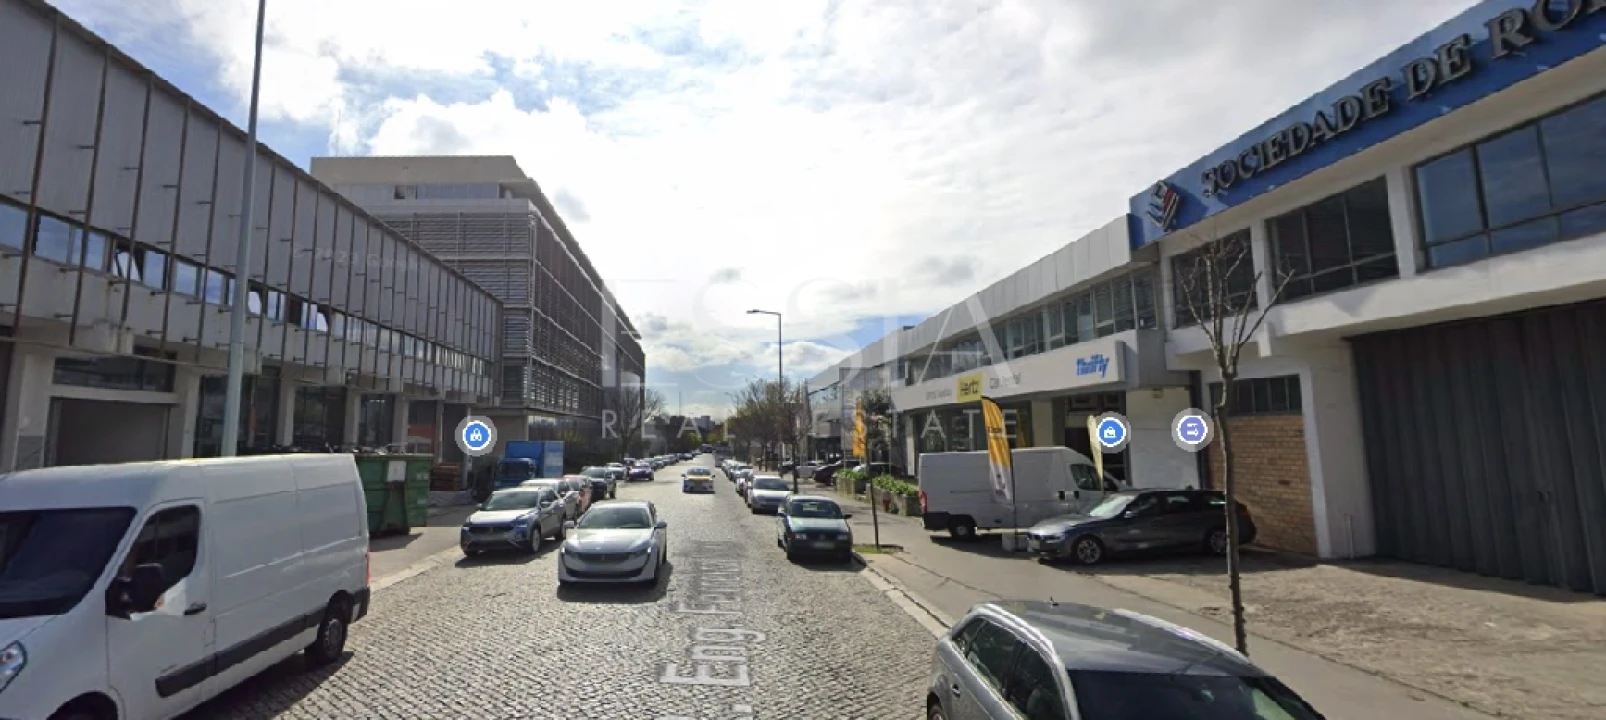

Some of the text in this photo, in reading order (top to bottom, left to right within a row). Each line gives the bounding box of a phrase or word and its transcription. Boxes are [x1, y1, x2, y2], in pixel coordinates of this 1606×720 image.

[1201, 0, 1606, 198] SOCIEDADE DE RO
